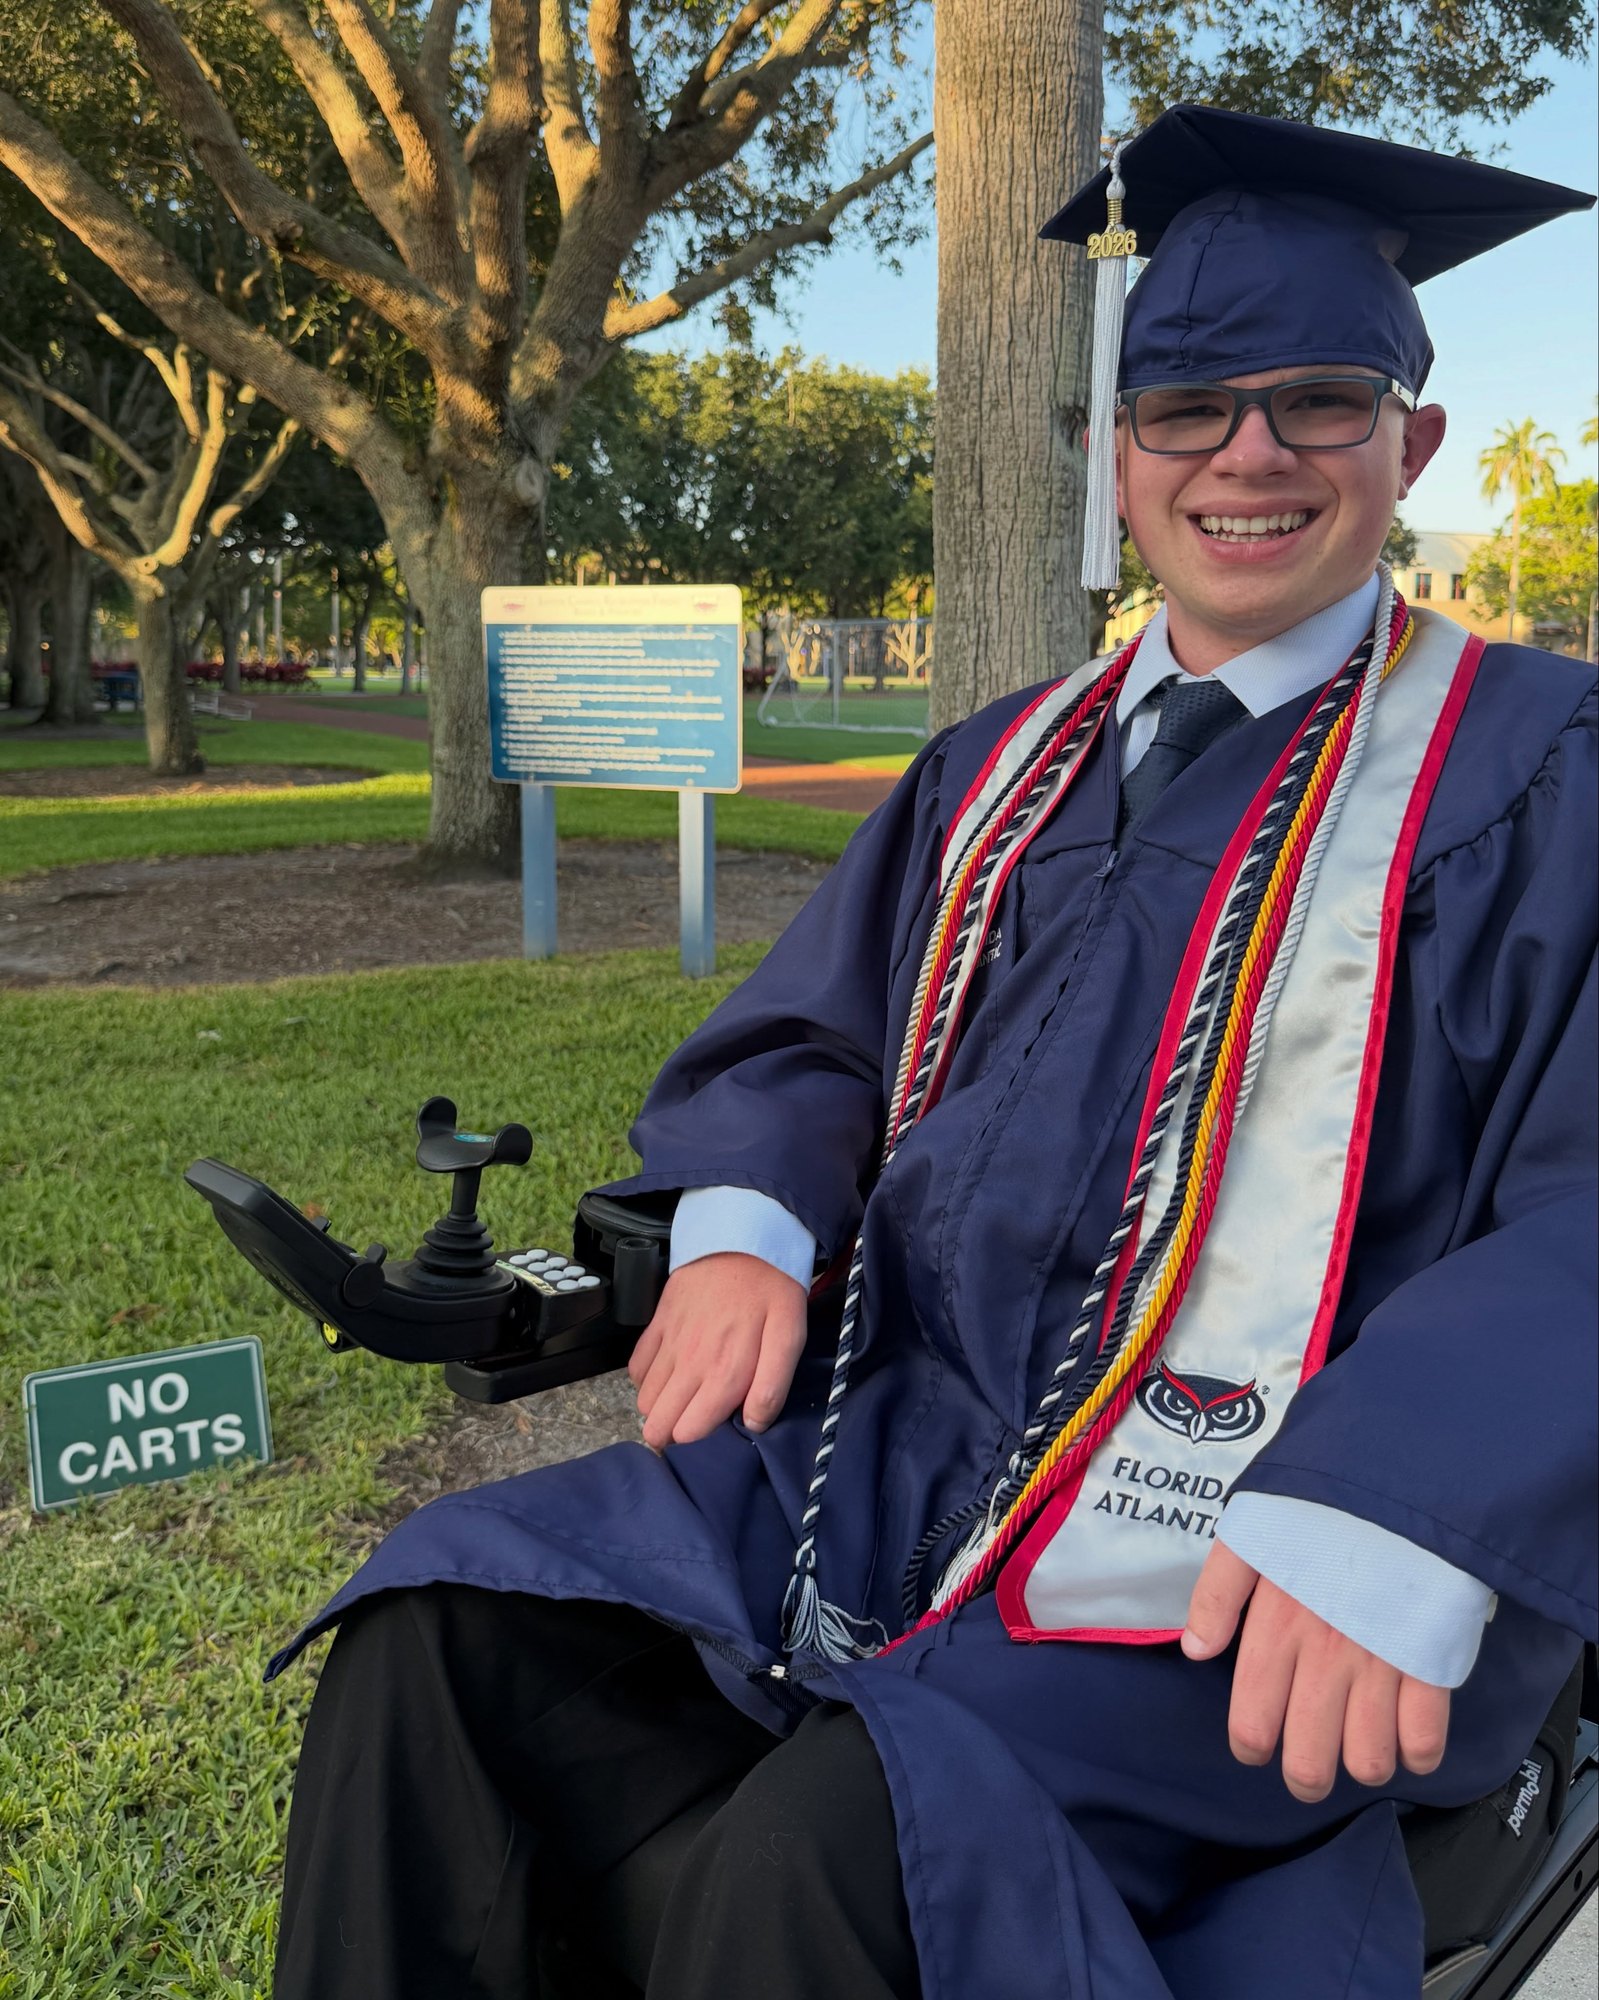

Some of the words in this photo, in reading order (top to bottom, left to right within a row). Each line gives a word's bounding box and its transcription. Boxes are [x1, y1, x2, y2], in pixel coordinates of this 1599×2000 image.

[1087, 229, 1137, 259] 2026
[107, 1372, 189, 1424] NO
[58, 1413, 246, 1484] CARTS
[1112, 1456, 1225, 1502] FLORID
[1093, 1490, 1219, 1539] ATLANTI
[1507, 1758, 1542, 1837] permobil
